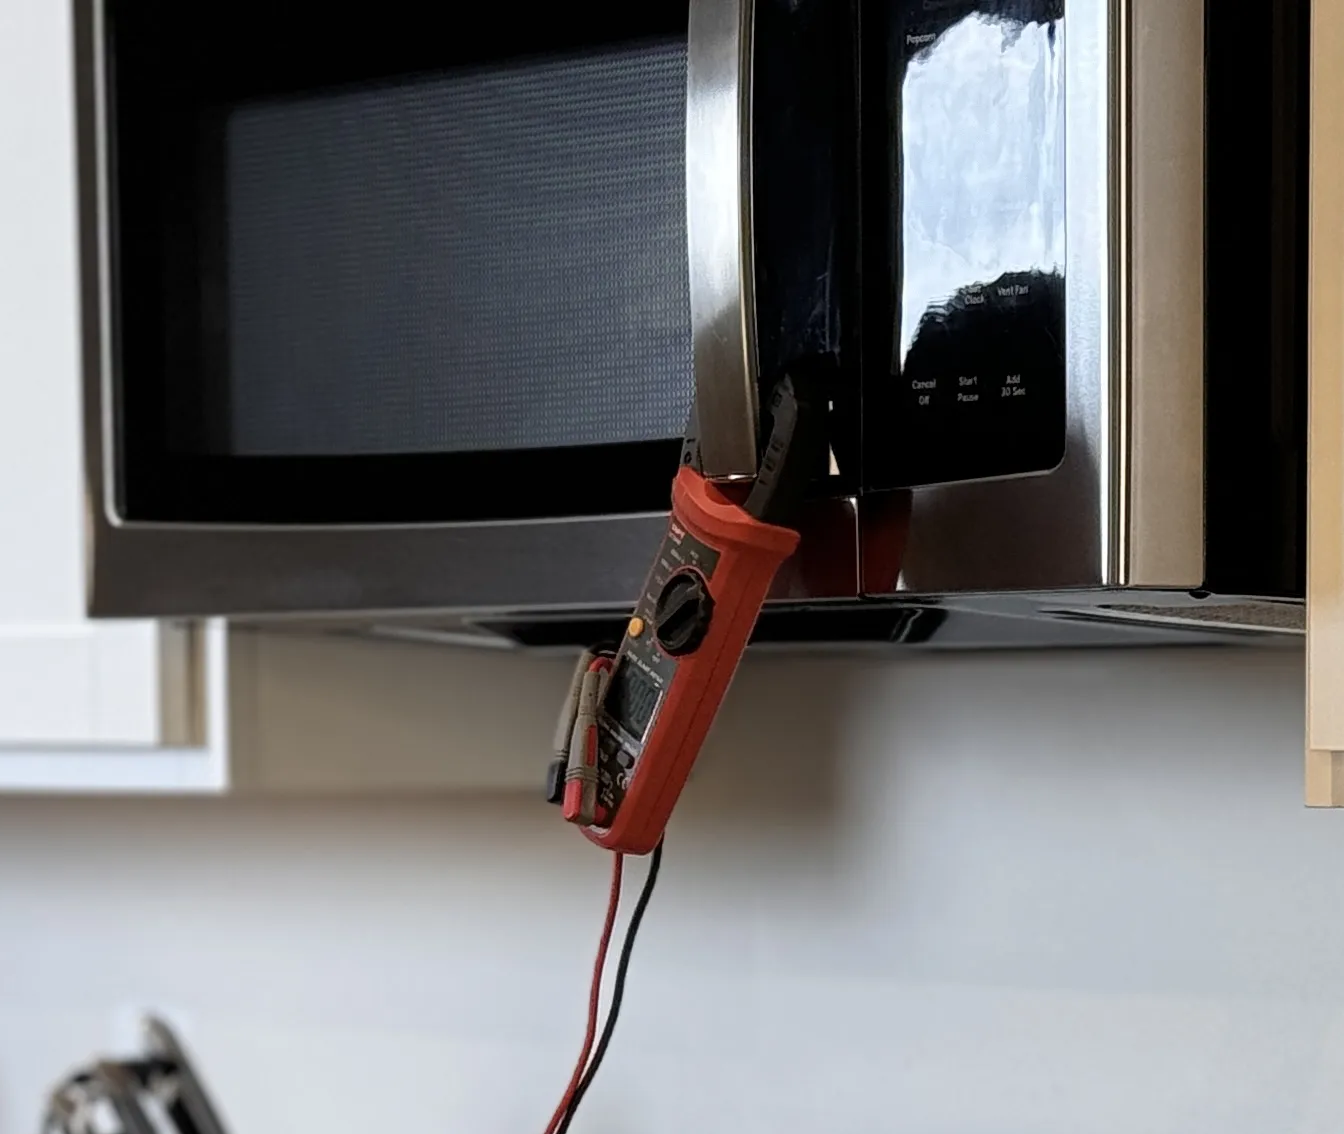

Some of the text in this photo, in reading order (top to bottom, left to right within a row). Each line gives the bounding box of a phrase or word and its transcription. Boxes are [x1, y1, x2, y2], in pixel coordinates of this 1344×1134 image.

[1014, 284, 1029, 296] Fan
[964, 293, 984, 306] Clock
[912, 379, 937, 390] Cancel
[958, 376, 978, 387] Start
[1006, 374, 1021, 385] Add
[1012, 386, 1026, 397] Sec
[918, 395, 930, 406] Off
[957, 393, 979, 403] Pause
